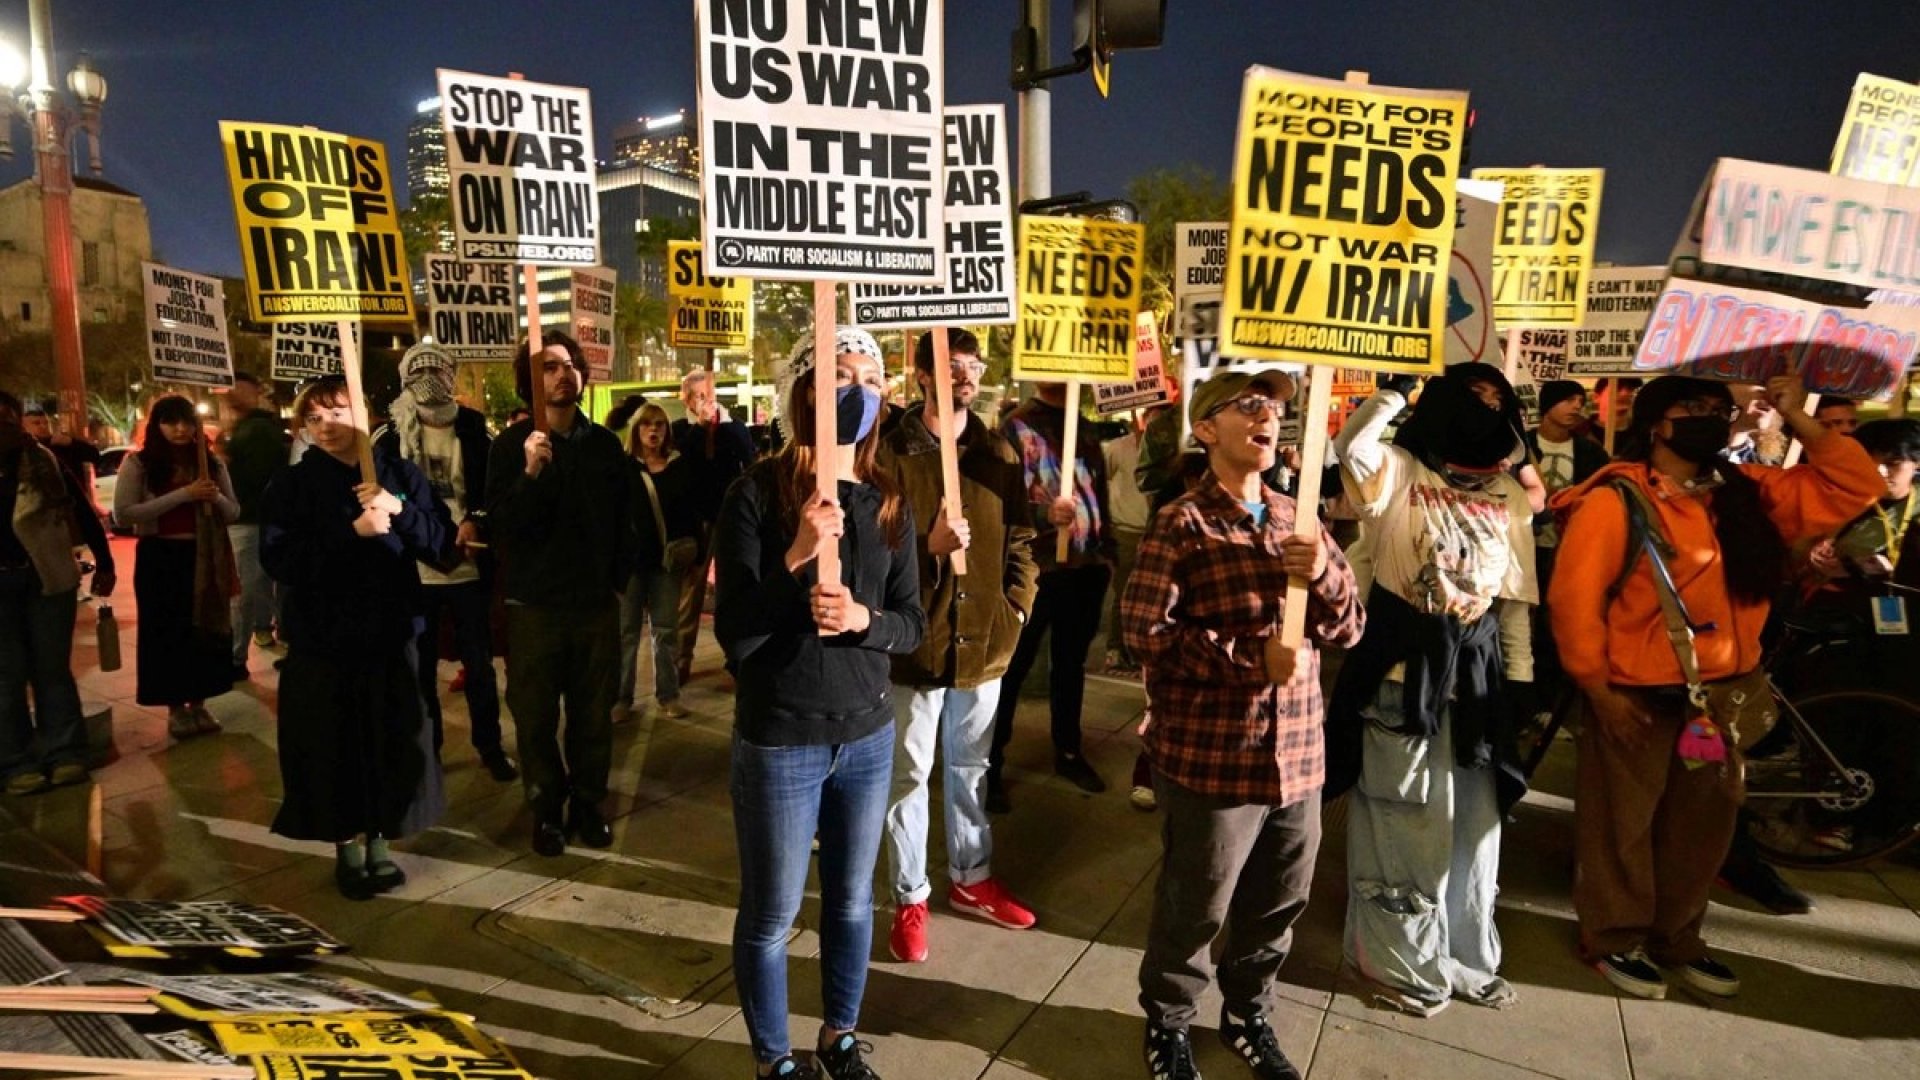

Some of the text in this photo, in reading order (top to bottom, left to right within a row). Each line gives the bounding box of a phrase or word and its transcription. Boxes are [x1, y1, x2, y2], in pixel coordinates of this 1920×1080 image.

[711, 0, 928, 56] NO NEW
[711, 41, 931, 113] US WAR
[449, 83, 581, 136] STOP THE
[1258, 89, 1453, 127] MONEY FOR
[944, 114, 995, 167] EW
[1254, 111, 1451, 152] PEOPLE'S
[233, 129, 383, 191] HANDS
[453, 125, 587, 173] WAR
[713, 120, 931, 181] IN THE
[944, 169, 1000, 206] AR
[1248, 137, 1446, 229] NEEDS
[243, 182, 388, 225] OFF
[459, 173, 594, 238] ON IRAN!
[715, 174, 931, 239] MIDDLE EAST
[944, 221, 1004, 253] HE
[1188, 228, 1229, 247] MONE
[1499, 202, 1587, 246] EEDS
[249, 226, 403, 292] IRAN!
[465, 242, 595, 260] PSLWEB.ORG
[746, 245, 932, 270] PARTY FOR SOCIALISM & LIBERATION
[1201, 248, 1226, 265] JOB
[1243, 227, 1438, 265] NOT WAR
[1492, 255, 1581, 267] OT WAR
[152, 268, 214, 298] MONEY FOR
[431, 259, 509, 284] STOP THE
[950, 256, 1005, 293] EAST
[1026, 249, 1135, 299] NEEDS
[1518, 270, 1580, 302] IRAN
[1596, 280, 1632, 294] CAN'T
[167, 289, 197, 309] JOBS
[264, 295, 405, 313] ANSWERCOALITION.ORG
[432, 283, 511, 306] WAR
[1241, 255, 1434, 329] W/ IRAN
[1586, 296, 1655, 312] MIDTERM
[678, 308, 743, 332] ON IRAN
[877, 305, 899, 319] PARTY
[902, 305, 917, 318] FOR
[918, 303, 958, 317] SOCIALISM
[966, 301, 1009, 315] LIBERATION
[1023, 303, 1130, 321] NOT WAR
[152, 330, 171, 345] NOT
[174, 333, 193, 347] FOR
[277, 322, 307, 336] US
[435, 310, 463, 345] ON
[1023, 318, 1129, 355] W/ IRAN
[1233, 318, 1429, 359] ANSWERCOALITION.ORG
[1576, 330, 1605, 343] STOP
[1609, 329, 1630, 343] THE
[276, 339, 341, 358] IN TH
[276, 352, 325, 371] MIDDLE
[1575, 344, 1591, 357] ON
[1595, 344, 1622, 357] IRAN
[1139, 364, 1160, 378] WAR
[1113, 384, 1135, 396] IRAN
